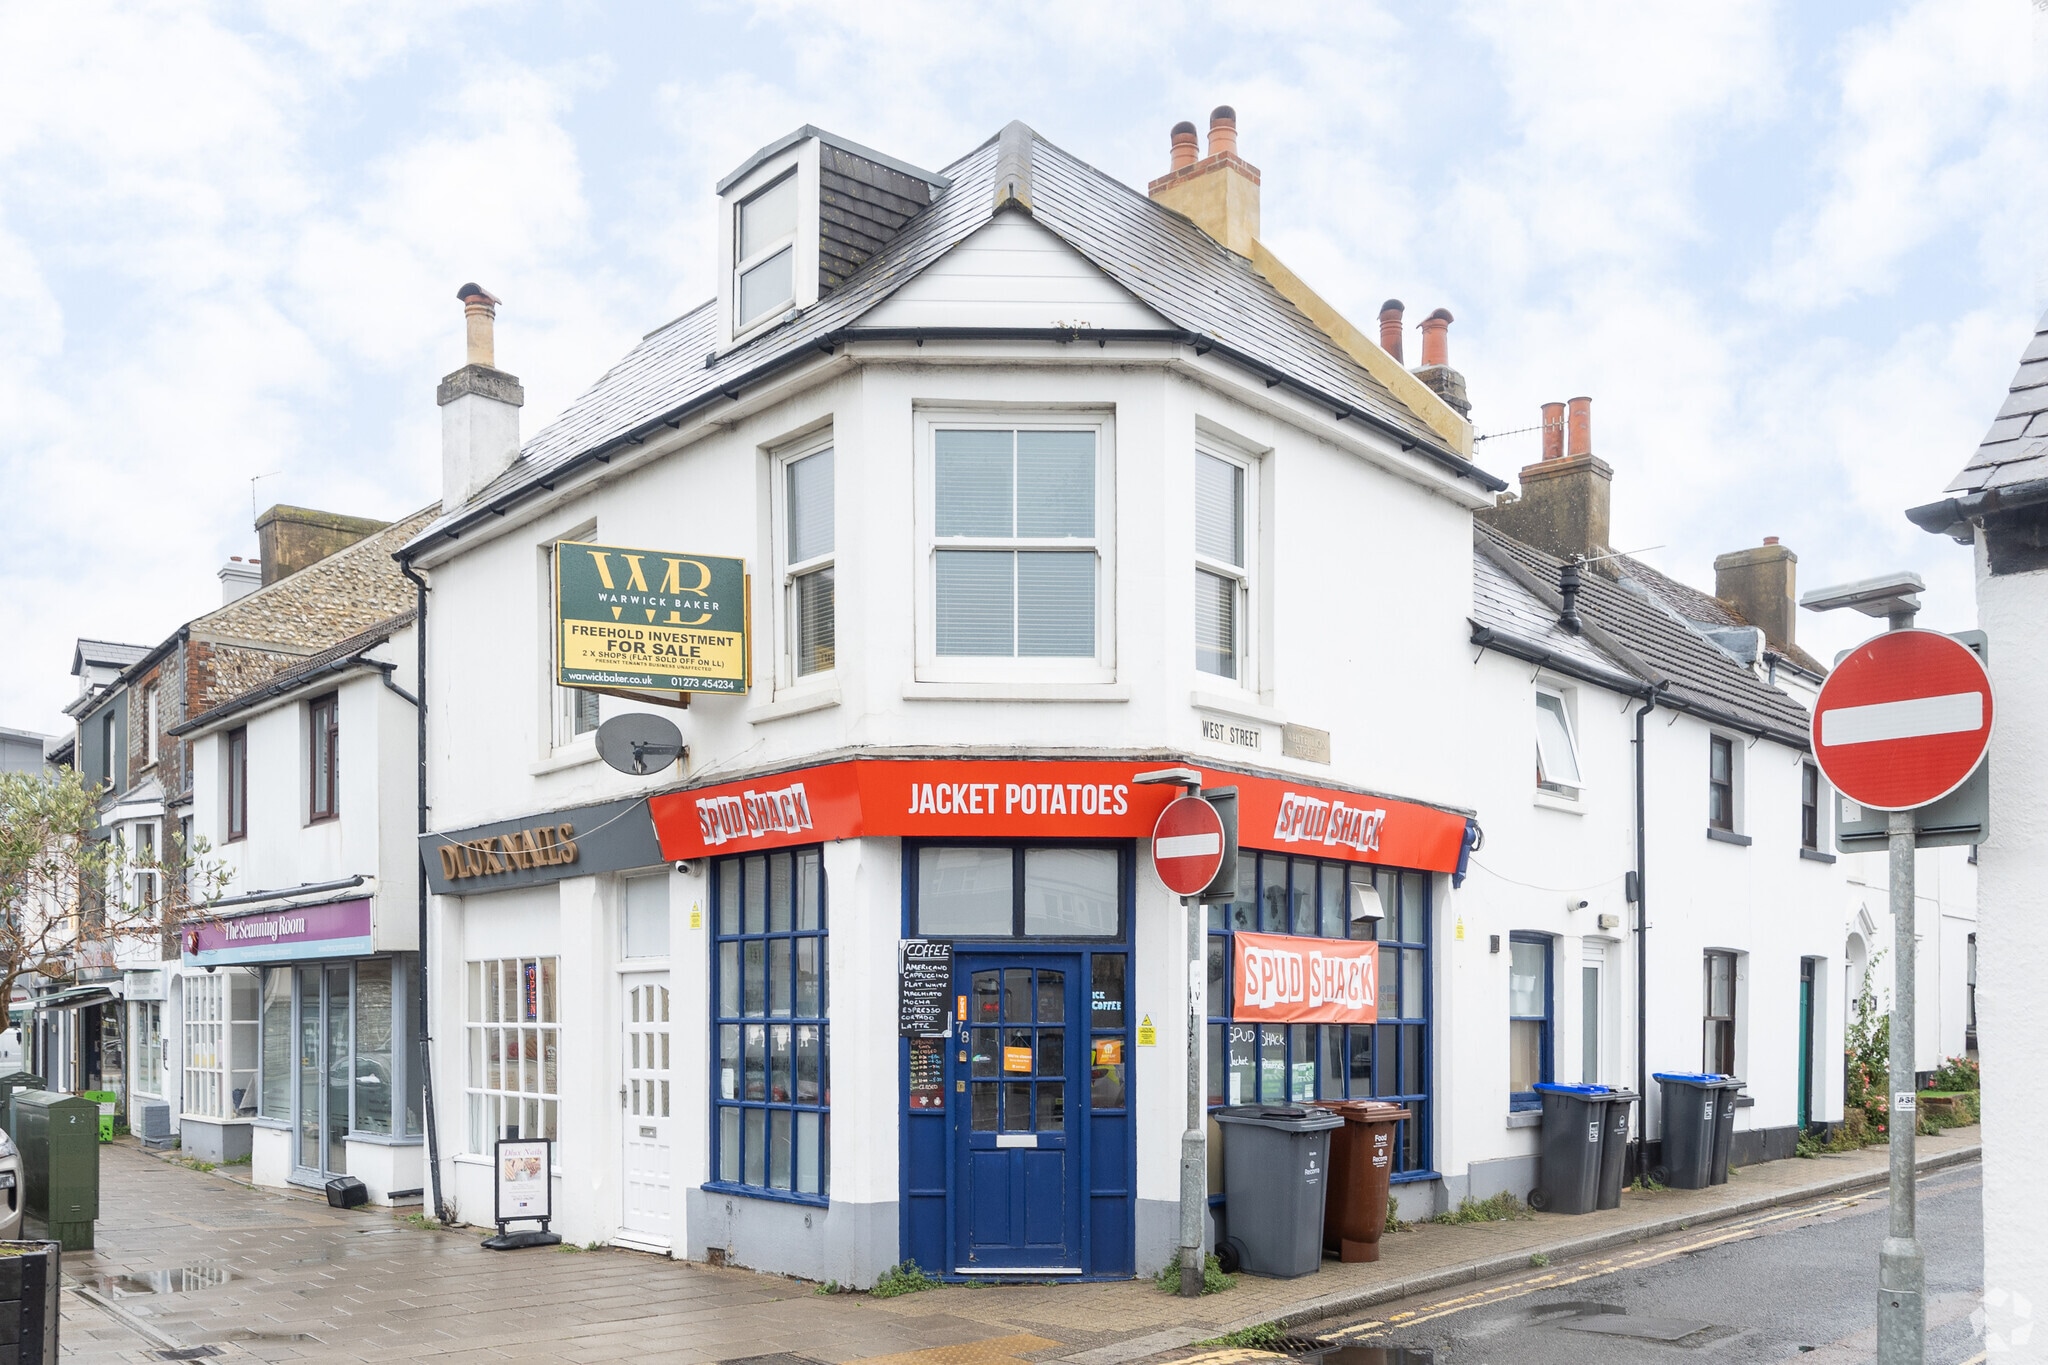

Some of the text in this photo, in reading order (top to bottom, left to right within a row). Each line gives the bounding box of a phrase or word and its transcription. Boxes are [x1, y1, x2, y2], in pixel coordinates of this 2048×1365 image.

[598, 593, 719, 611] WARWICK BAKER
[572, 625, 734, 647] FREEHOLD INVESTMENT
[607, 640, 701, 658] FOR SALE
[598, 651, 627, 660] SHOPS
[629, 653, 653, 662] (FLAT
[655, 656, 677, 664] SOLD
[679, 657, 695, 665] OFF
[712, 660, 725, 669] LL)
[568, 672, 734, 690] warwickbaker.co.uk 01273 454234
[1202, 719, 1259, 749] WEST STREET
[908, 783, 1128, 815] JACKET POTATOES
[697, 785, 812, 844] SPUD SHACK
[1276, 794, 1385, 851] SPUD SHACK
[439, 823, 578, 880] DLUX NAILS
[224, 915, 305, 942] The Scanning Room
[906, 944, 949, 958] COFFEE
[905, 963, 948, 971] AMERICANO
[1245, 949, 1302, 1005] SPUD
[1309, 952, 1374, 1006] SHACK
[528, 968, 537, 1015] OPEN
[1092, 991, 1105, 999] ICE
[902, 1006, 941, 1014] ESPRESSO
[1091, 1001, 1122, 1011] COFFEE
[1229, 1026, 1286, 1047] SPUD SHACK
[1229, 1050, 1249, 1067] Jacket
[70, 1115, 76, 1124] 2
[1374, 1133, 1388, 1142] Food
